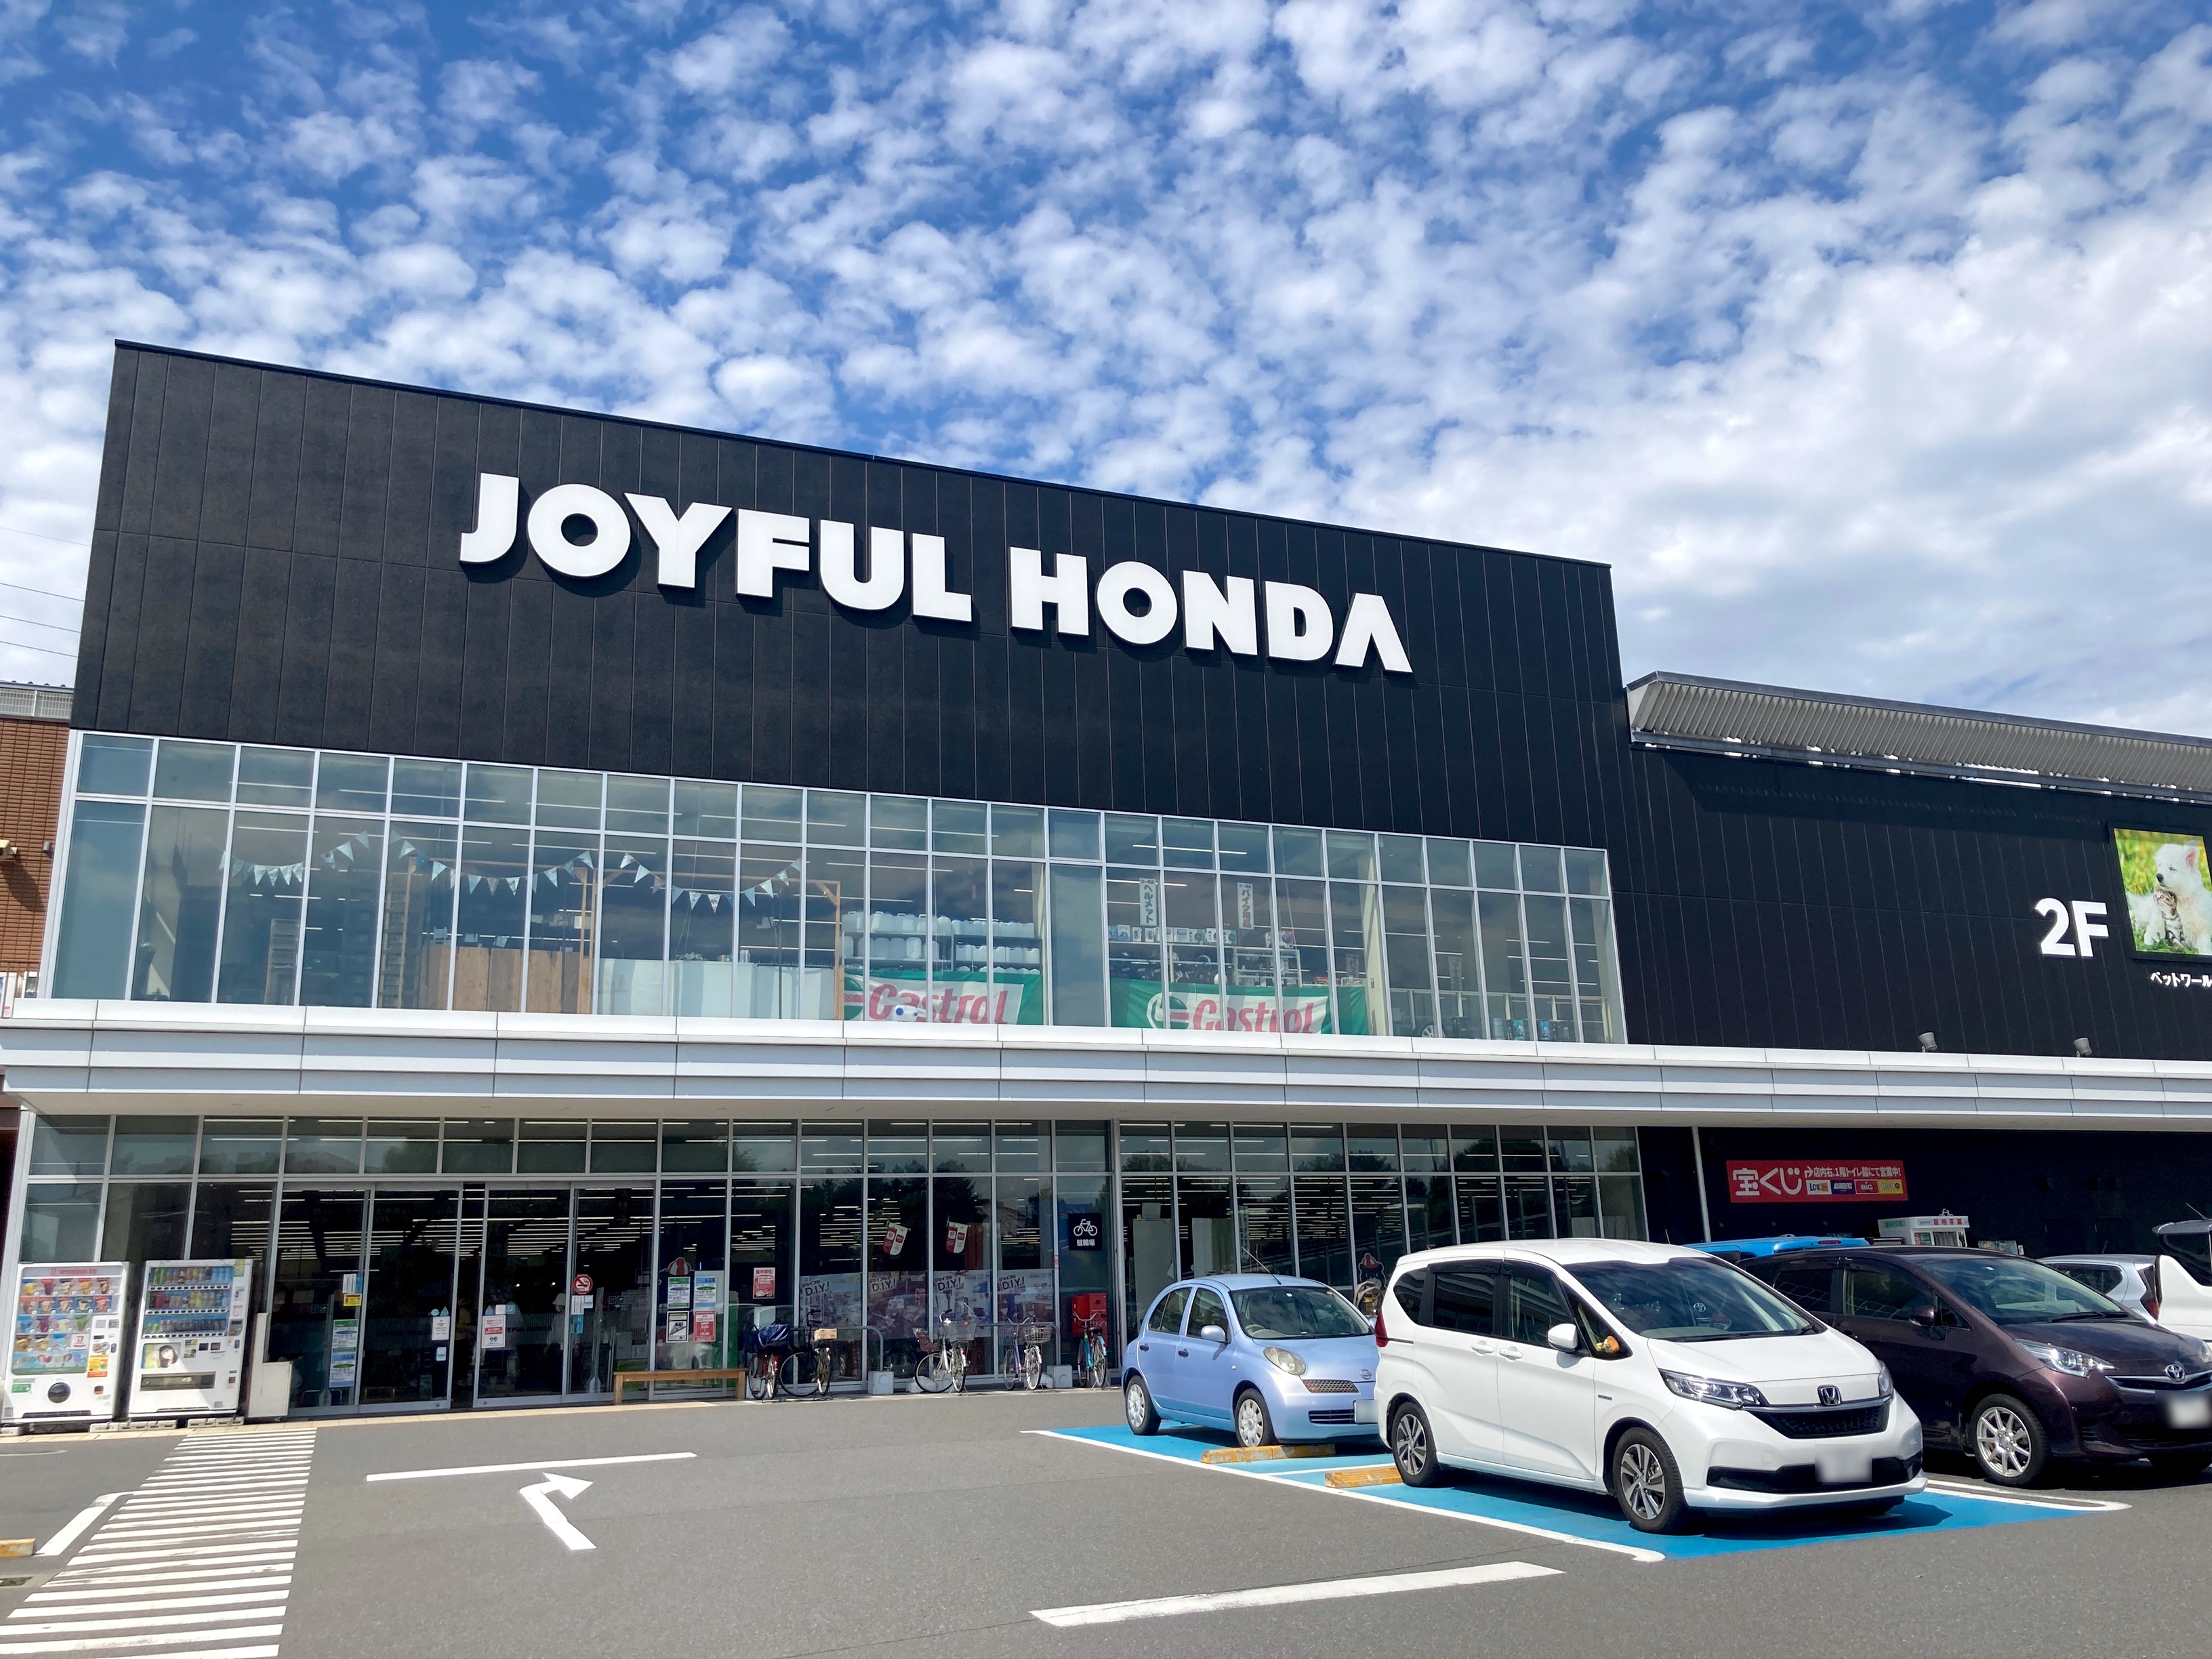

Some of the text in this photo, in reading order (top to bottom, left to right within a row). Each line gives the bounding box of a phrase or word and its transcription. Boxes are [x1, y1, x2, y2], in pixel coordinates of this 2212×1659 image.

[459, 472, 1413, 673] JOYFUL HONDA
[1143, 884, 1153, 924] ヘルメット
[1242, 888, 1252, 928] バイク用品
[2035, 898, 2109, 958] 2F
[869, 984, 1008, 1025] Castrol
[1733, 1167, 1802, 1196] 宝くじ
